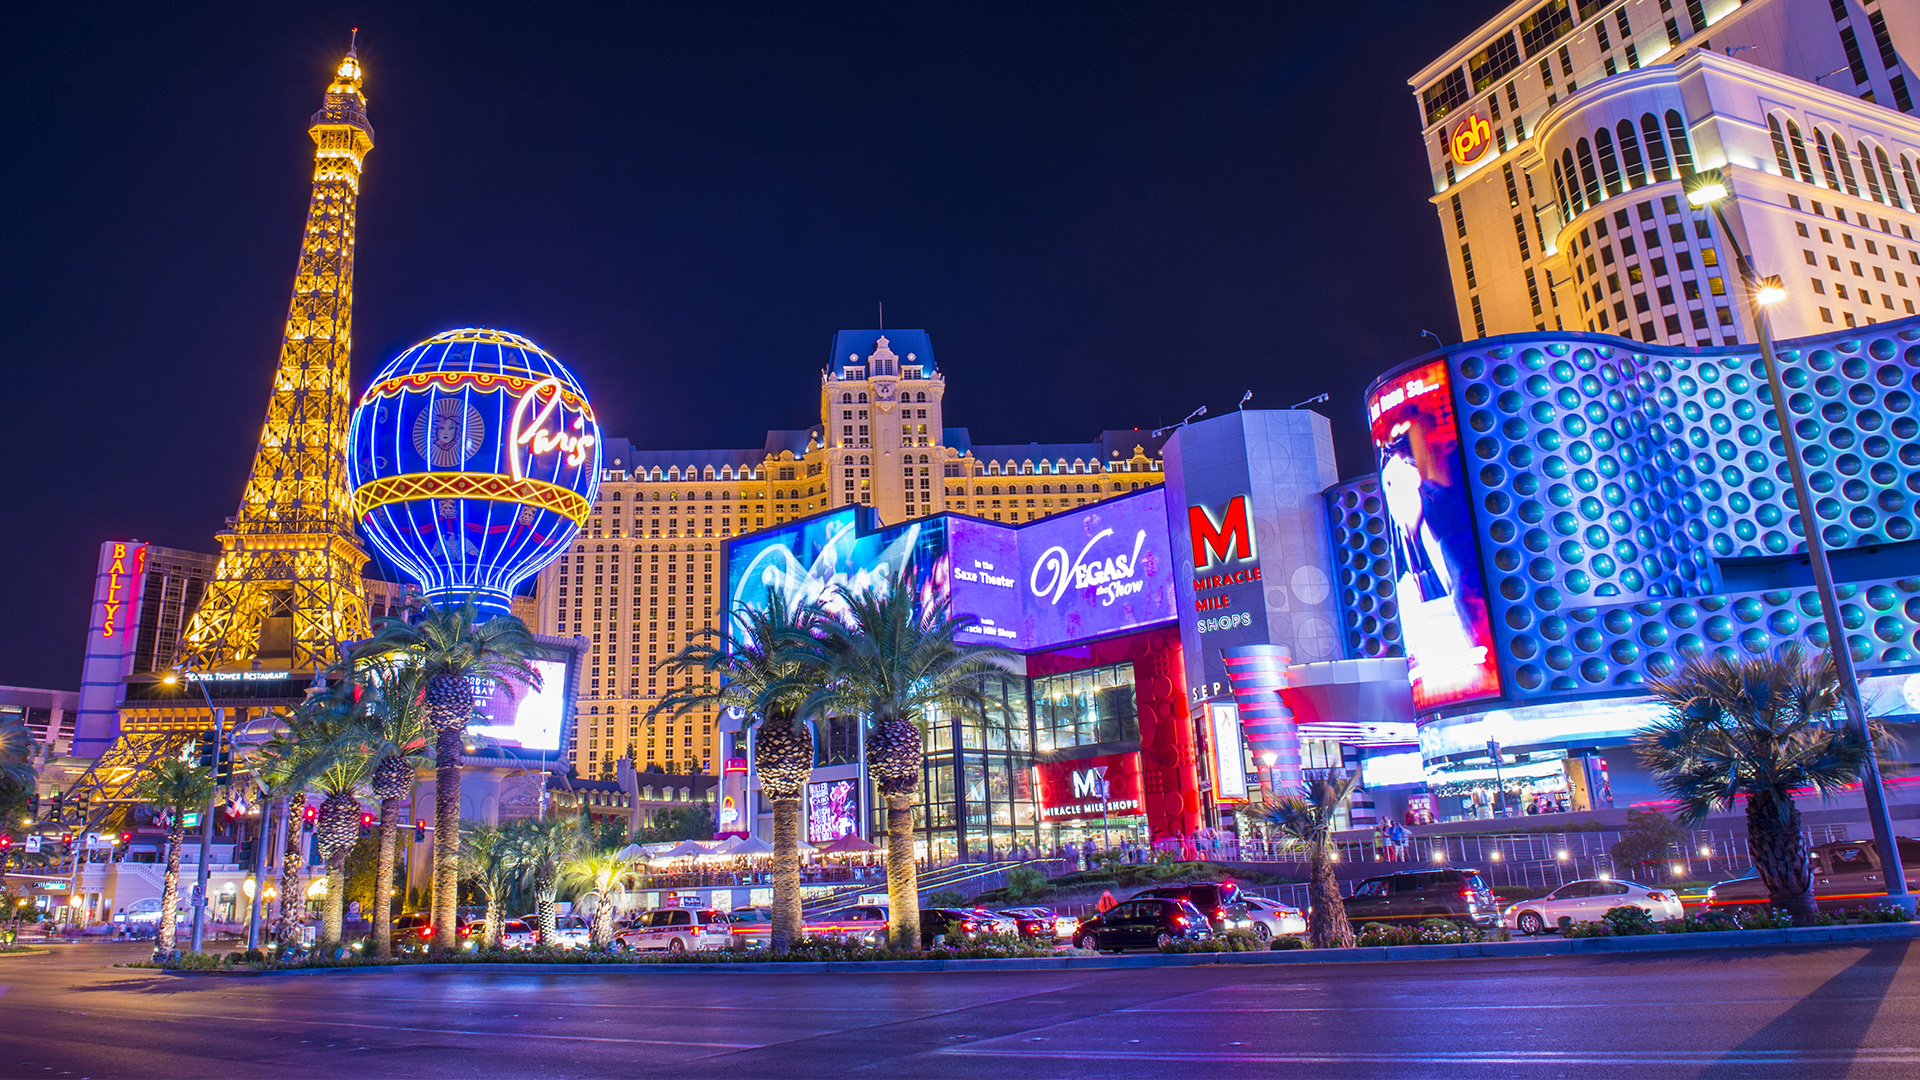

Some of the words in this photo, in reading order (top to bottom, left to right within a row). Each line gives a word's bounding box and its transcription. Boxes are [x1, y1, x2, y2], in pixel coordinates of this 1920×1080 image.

[1456, 113, 1490, 161] ph
[510, 378, 595, 482] Paris
[1188, 494, 1256, 571] M
[982, 561, 994, 571] the
[954, 568, 978, 583] Saxe
[979, 572, 1015, 588] Theater
[1193, 567, 1262, 591] MIRACLE
[103, 543, 126, 637] BALLYS
[1102, 579, 1143, 606] Show
[1195, 594, 1231, 612] MILE
[1197, 612, 1251, 633] SHOPS
[215, 671, 242, 681] TOWER
[243, 671, 290, 680] RESTAURANT
[1043, 803, 1081, 816] MIRACLE
[1084, 802, 1104, 813] MILE
[1107, 799, 1139, 810] SHOPS
